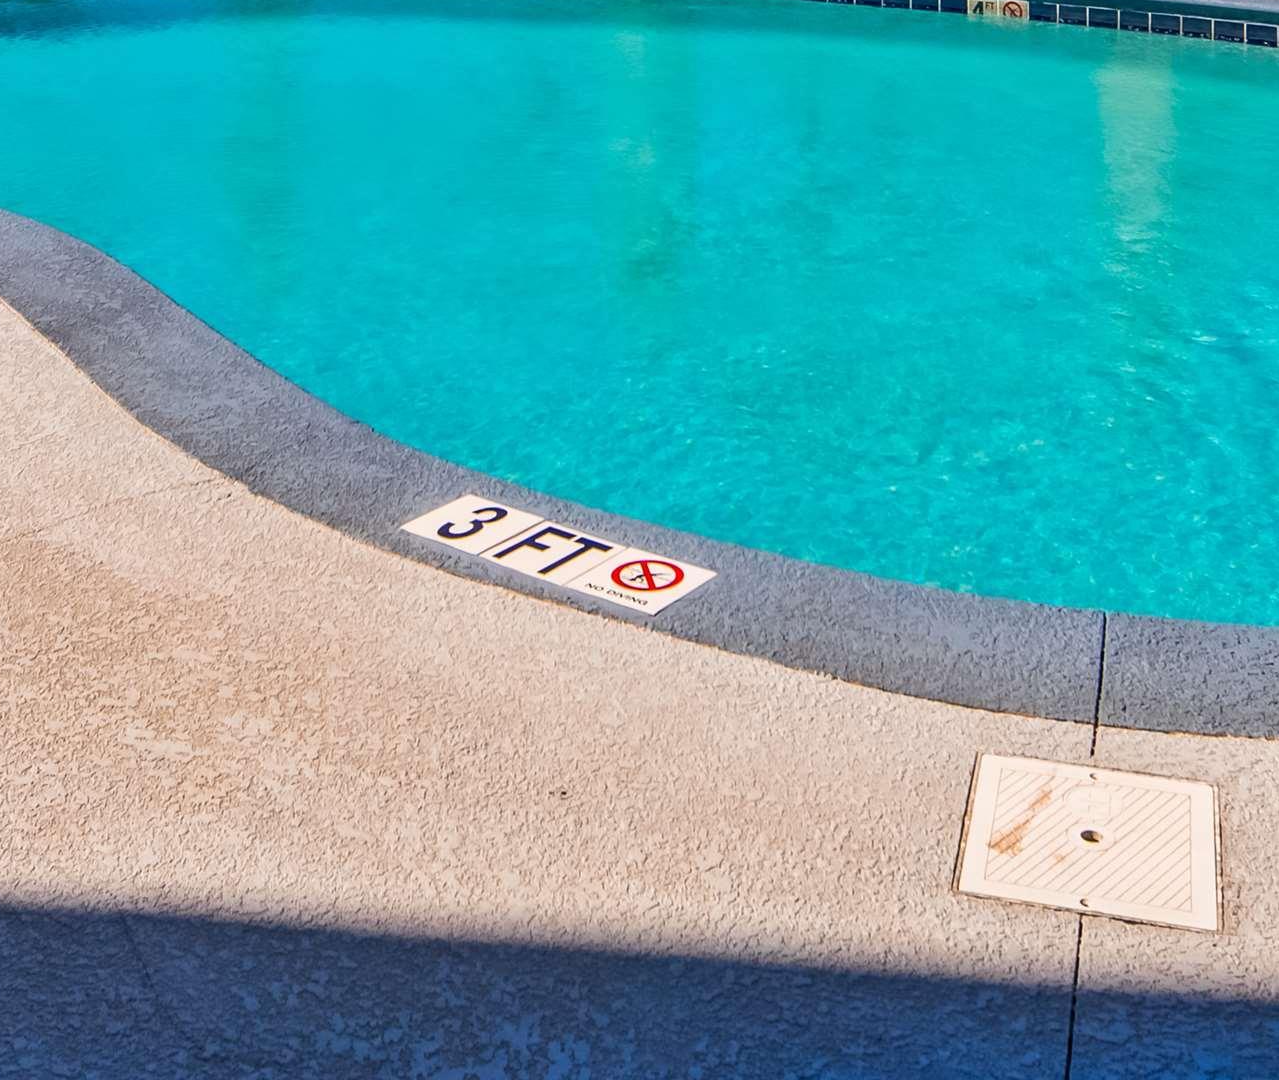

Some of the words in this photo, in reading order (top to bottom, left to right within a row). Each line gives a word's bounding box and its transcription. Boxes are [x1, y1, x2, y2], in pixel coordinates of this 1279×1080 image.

[973, 1, 984, 15] 4
[437, 506, 508, 539] 3
[493, 526, 613, 575] FT
[584, 582, 604, 592] NO
[606, 589, 648, 607] DIVING
